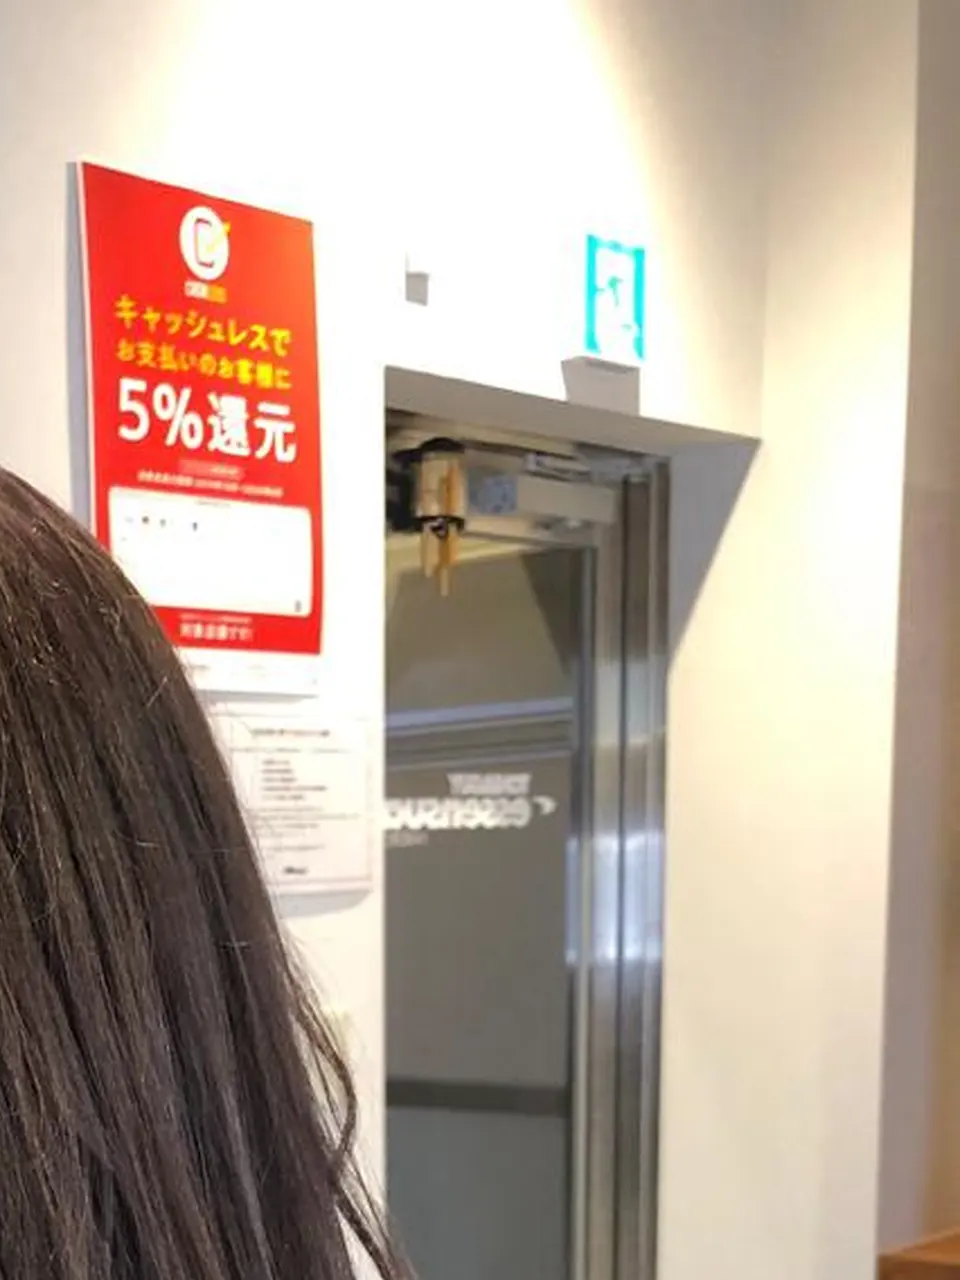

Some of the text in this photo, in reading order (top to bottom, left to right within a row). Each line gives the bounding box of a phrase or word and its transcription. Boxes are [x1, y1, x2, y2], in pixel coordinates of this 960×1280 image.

[116, 294, 292, 357] キャッシュレスで
[118, 376, 297, 463] 5%還元
